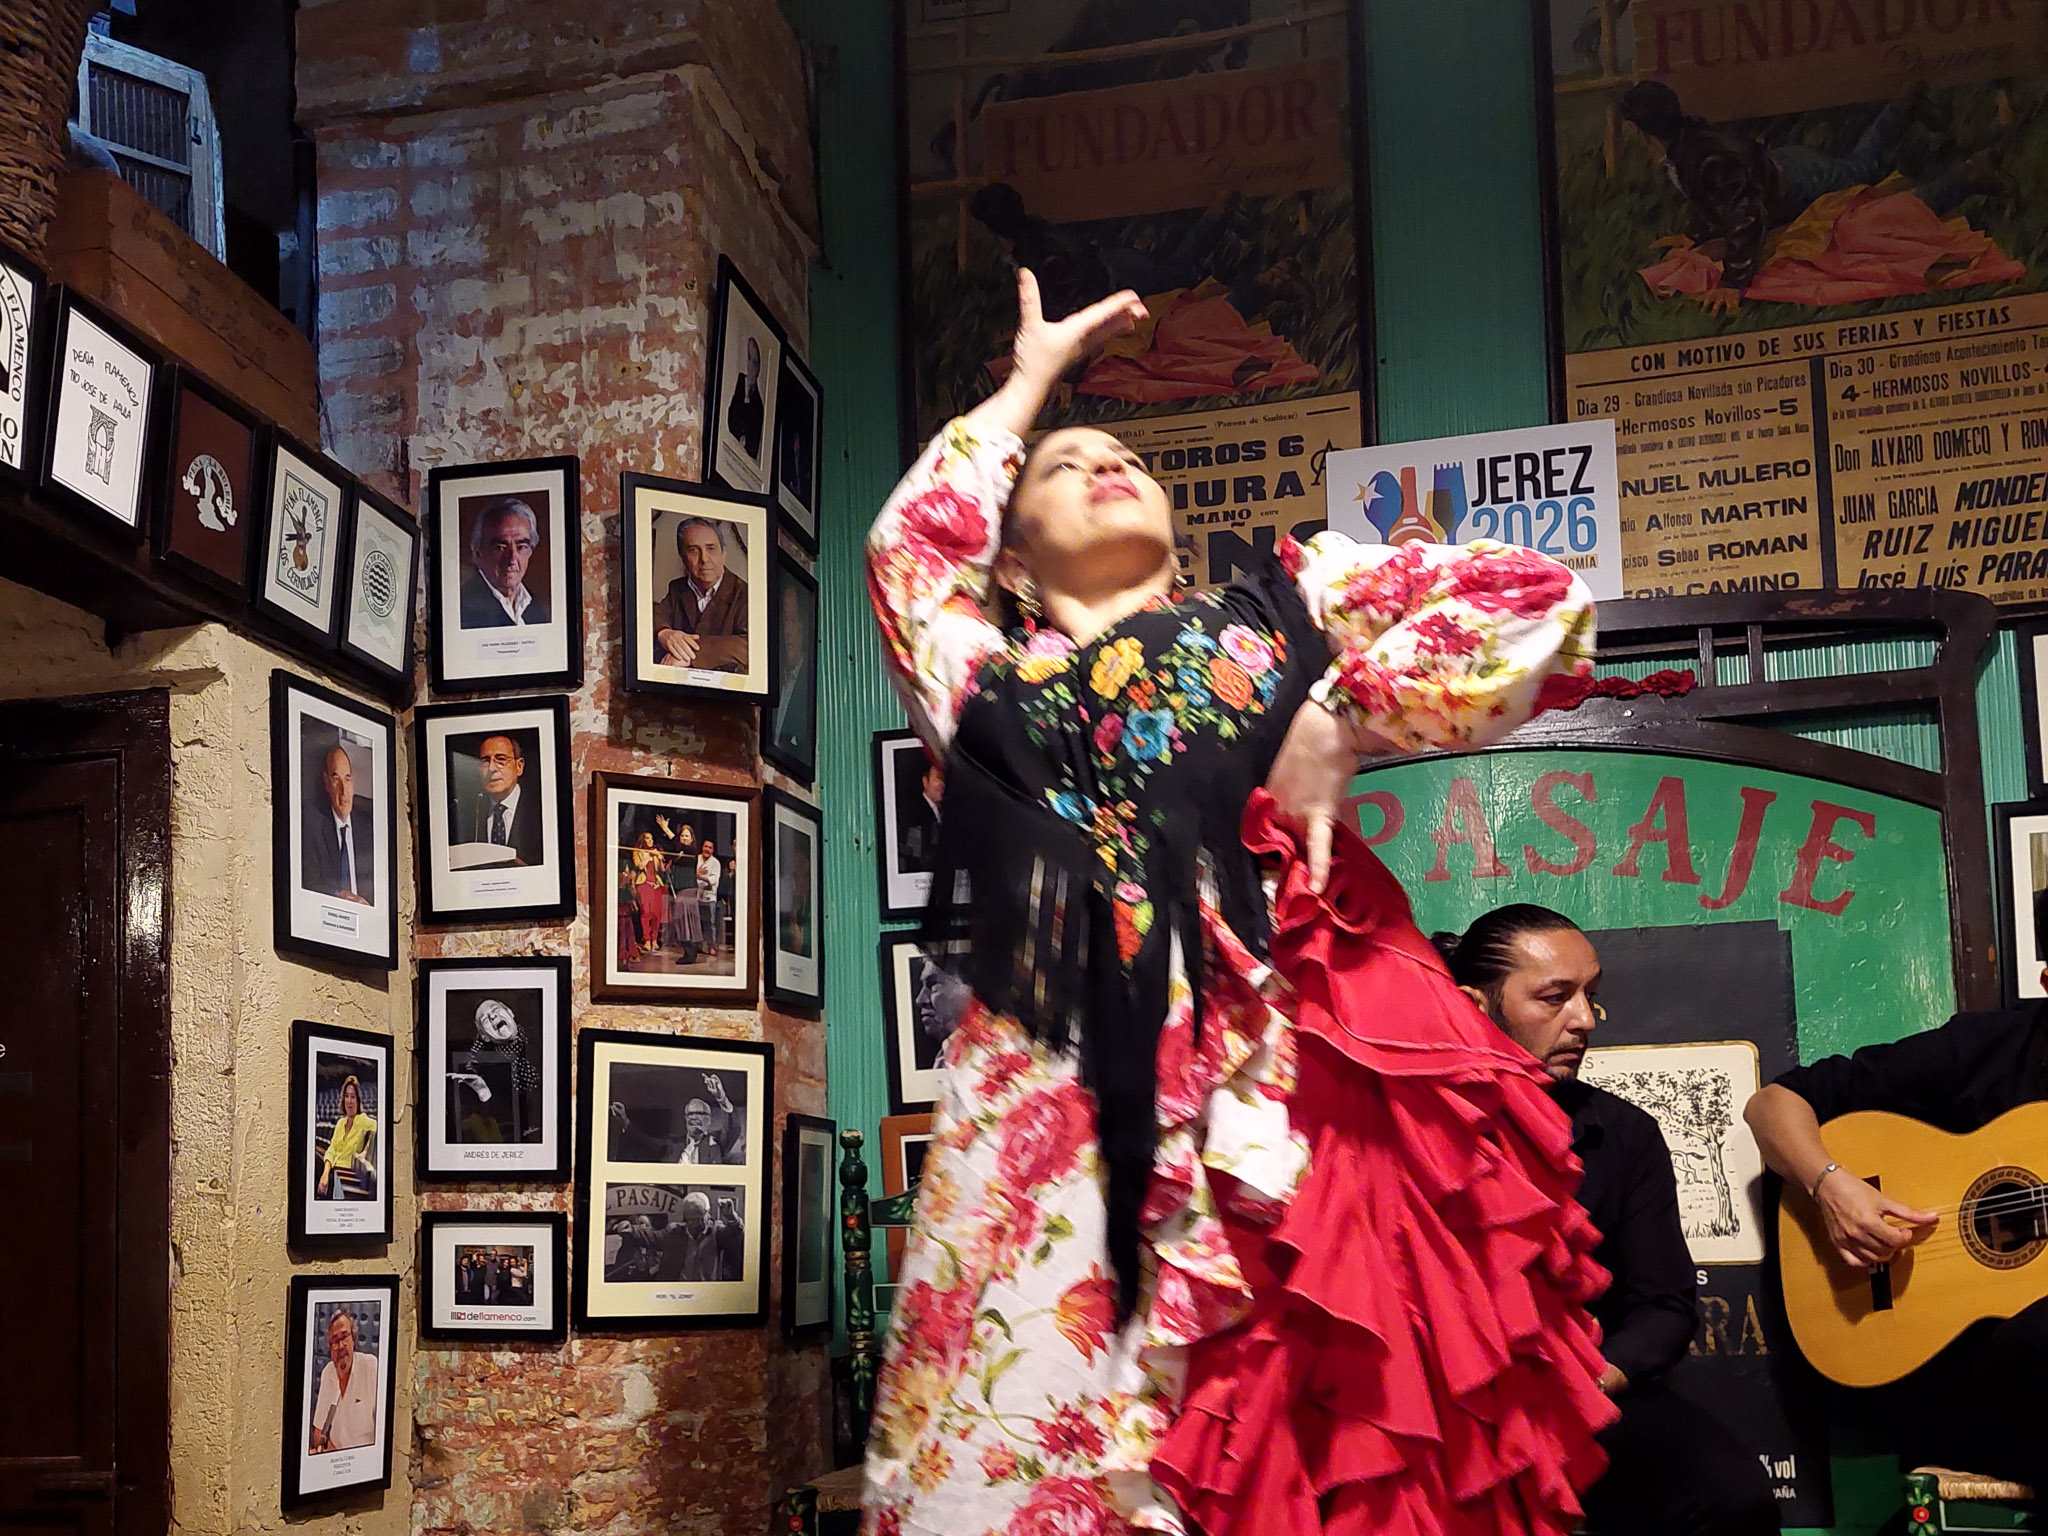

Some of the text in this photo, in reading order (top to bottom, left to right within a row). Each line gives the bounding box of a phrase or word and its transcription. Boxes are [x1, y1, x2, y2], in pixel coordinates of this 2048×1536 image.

[1001, 77, 1318, 178] FUNDADOR
[6, 292, 25, 403] FLAMENCO
[72, 348, 95, 368] PEÑA
[1631, 306, 2012, 373] CON MOTIVO DE SUS FERIAS Y FIESTAS
[1857, 356, 1875, 377] 30
[81, 379, 98, 398] JOSE
[99, 390, 108, 405] DE
[1604, 395, 1620, 414] 29
[1688, 383, 1734, 401] Novillada
[1737, 379, 1753, 395] sin
[1757, 373, 1808, 393] Picadores
[1214, 418, 1247, 429] (Patrona
[1249, 416, 1259, 425] de
[1138, 434, 1304, 474] TOROS 6
[1834, 443, 1860, 473] Don
[1871, 434, 1924, 468] ALVARO
[1933, 425, 1992, 461] DOMECQ
[2000, 422, 2009, 452] Y
[1163, 470, 1306, 511] IURA
[1471, 445, 1595, 508] JEREZ
[1619, 474, 1690, 499] NUEL
[1698, 459, 1811, 489] MULERO
[1621, 516, 1636, 534] nio
[1701, 496, 1807, 526] MARTIN
[1839, 493, 1876, 525] JUAN
[1888, 485, 1939, 519] GARCIA
[1472, 496, 1597, 555] 2026
[1863, 524, 1934, 560] RUIZ
[1555, 554, 1598, 571] NOMÍA
[1623, 553, 1649, 569] cisco
[1708, 534, 1808, 562] ROMAN
[1686, 572, 1800, 598] CAMINO
[1917, 558, 1969, 588] Luis
[1342, 770, 1877, 916] PASAJE
[464, 1150, 524, 1159] ANDRÉS DE JEREZ
[616, 1188, 678, 1213] PASAJE
[1774, 1454, 1796, 1479] vol
[1772, 1485, 1797, 1499] AÑA
